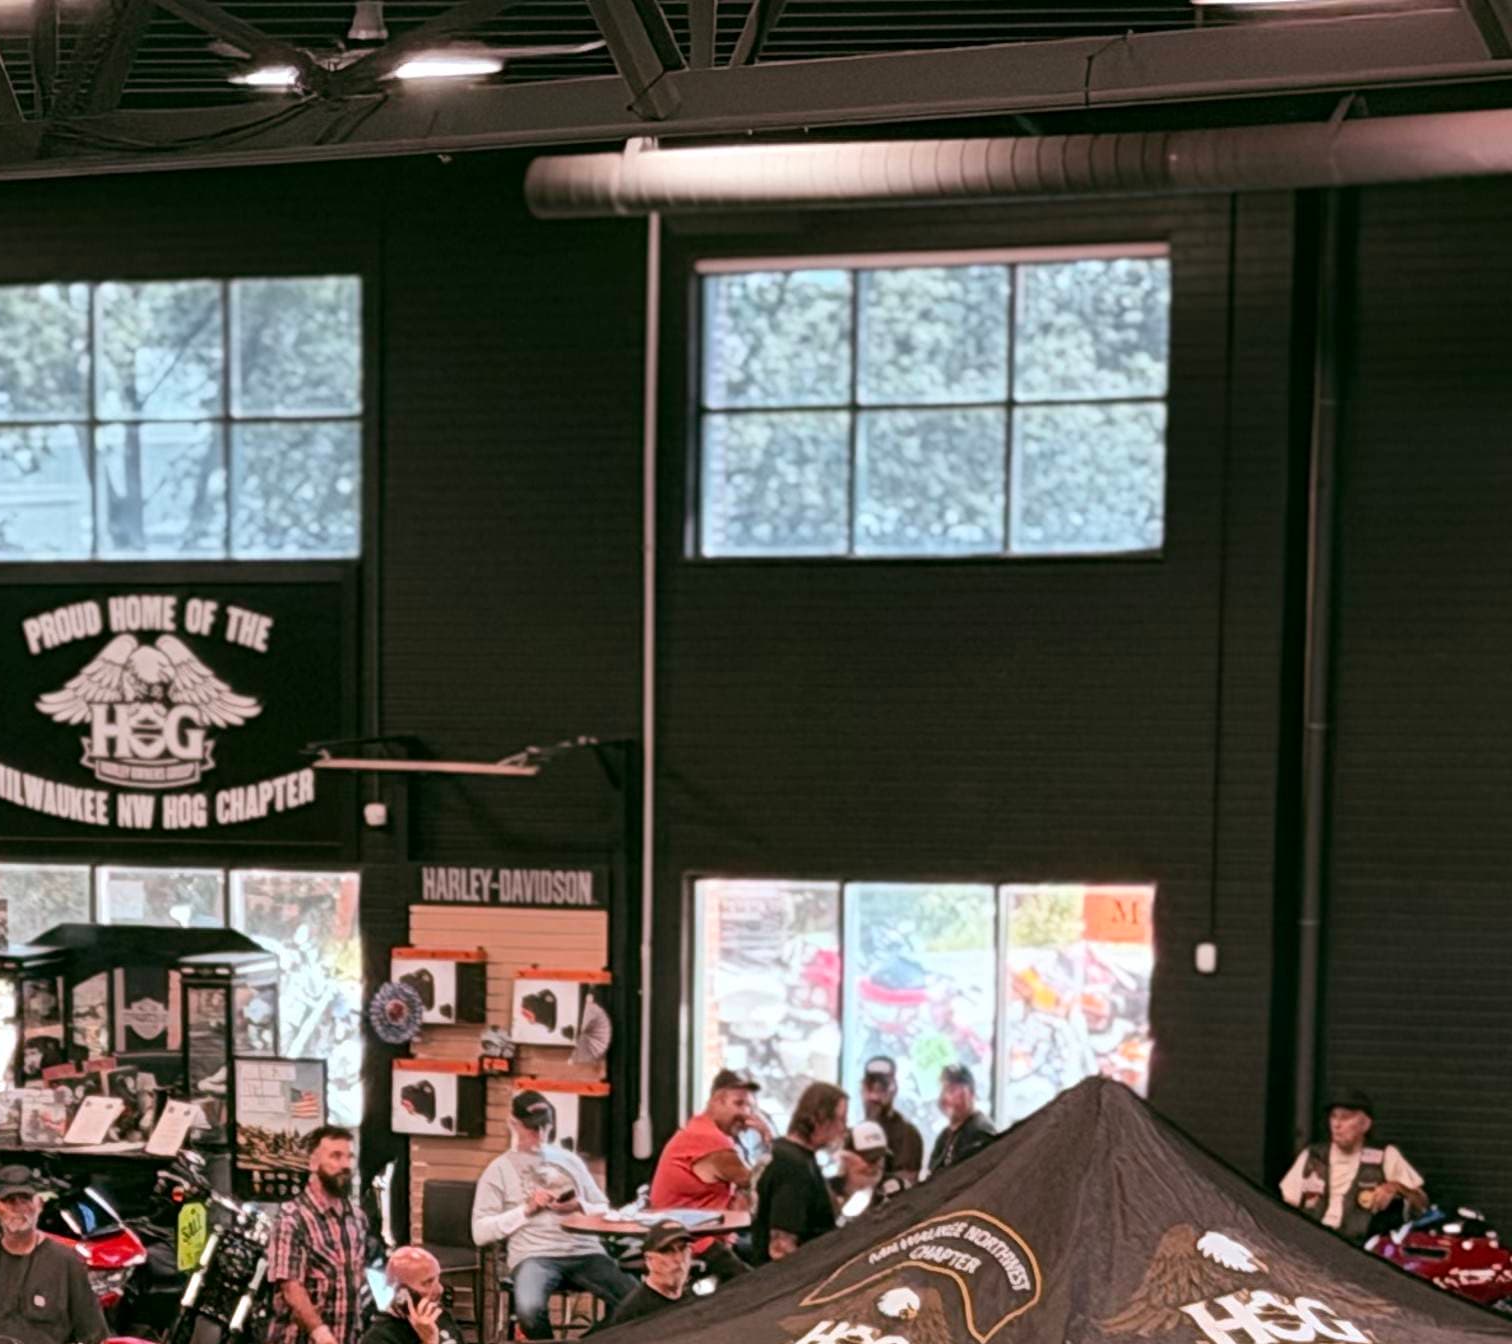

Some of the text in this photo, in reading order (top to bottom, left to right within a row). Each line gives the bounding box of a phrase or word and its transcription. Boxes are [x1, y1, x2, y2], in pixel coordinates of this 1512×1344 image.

[23, 595, 273, 654] PROUD HOME OF THE
[117, 792, 154, 829] NW
[163, 790, 207, 829] HOG
[216, 767, 315, 825] CHAPTER
[422, 867, 593, 905] HARLEY-DAVIDSON
[908, 1245, 982, 1275] CHAPTER
[964, 1225, 1032, 1292] NORTHWEST
